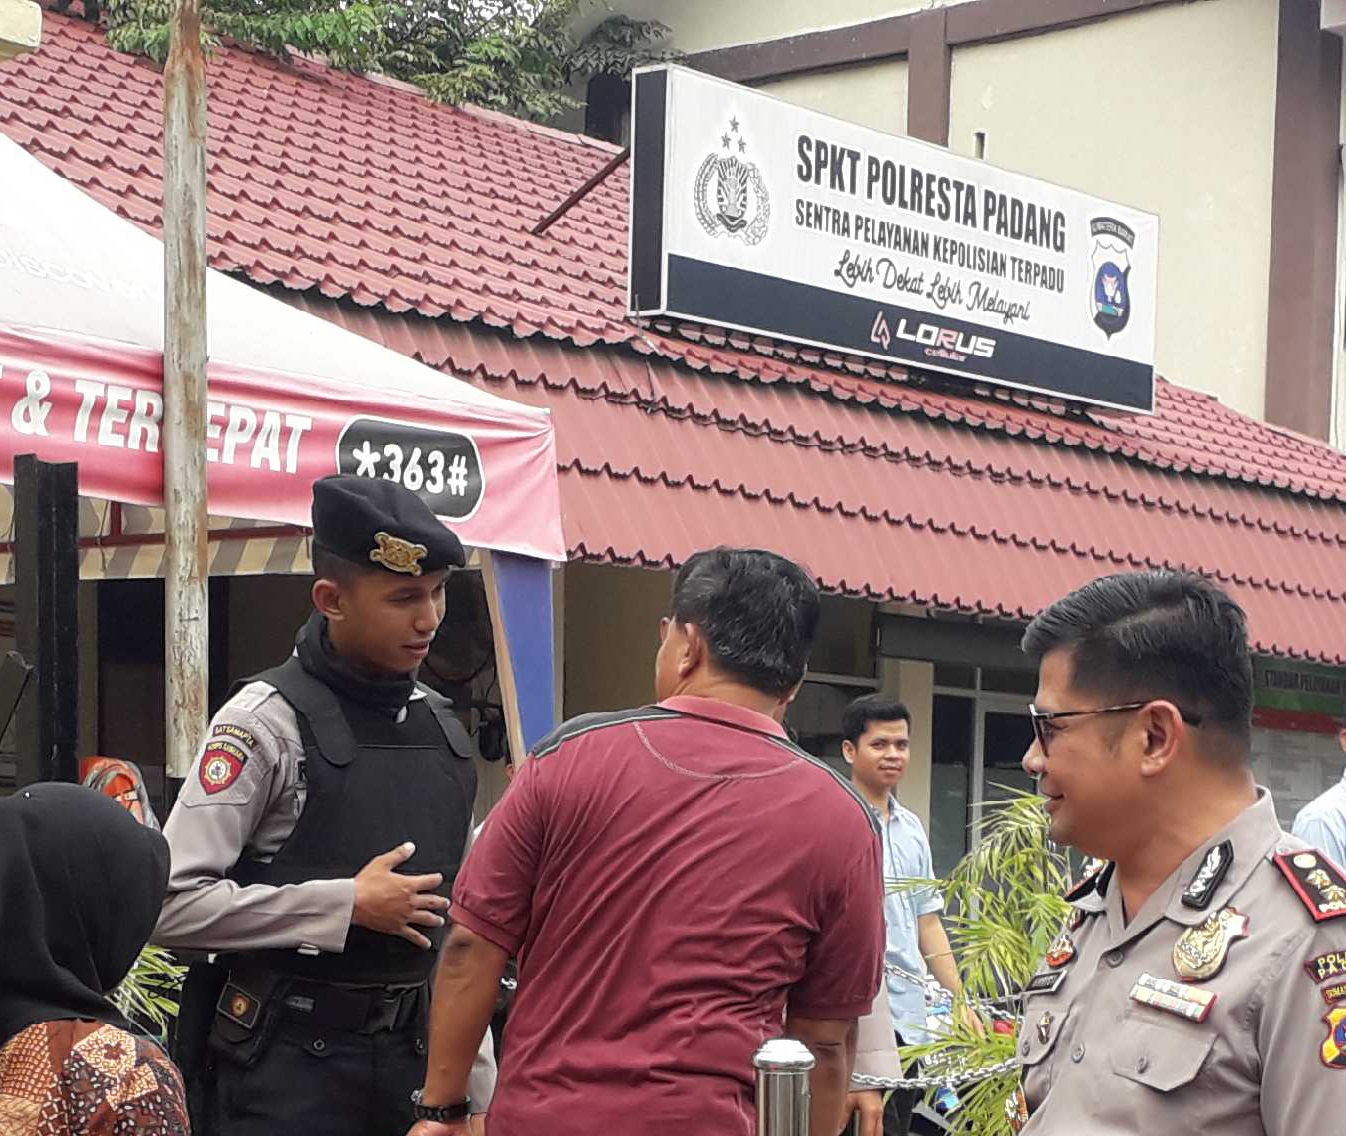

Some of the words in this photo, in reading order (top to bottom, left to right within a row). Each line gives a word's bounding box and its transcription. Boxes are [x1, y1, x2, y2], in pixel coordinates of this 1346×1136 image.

[797, 135, 861, 195] SPKT
[867, 155, 977, 228] POLRESTA
[983, 189, 1066, 253] PADANG
[796, 198, 851, 238] SENTRA
[855, 214, 929, 258] PELAYANAN
[933, 234, 1006, 278] KEPOLISIAN
[1010, 256, 1065, 293] TERPADU
[834, 249, 874, 288] Lebih
[876, 257, 925, 296] Dekat
[926, 272, 963, 310] Lebih
[966, 281, 1030, 324] Melayani
[896, 318, 997, 358] LORUS
[11, 368, 52, 438] &
[73, 379, 313, 474] TEREPAT
